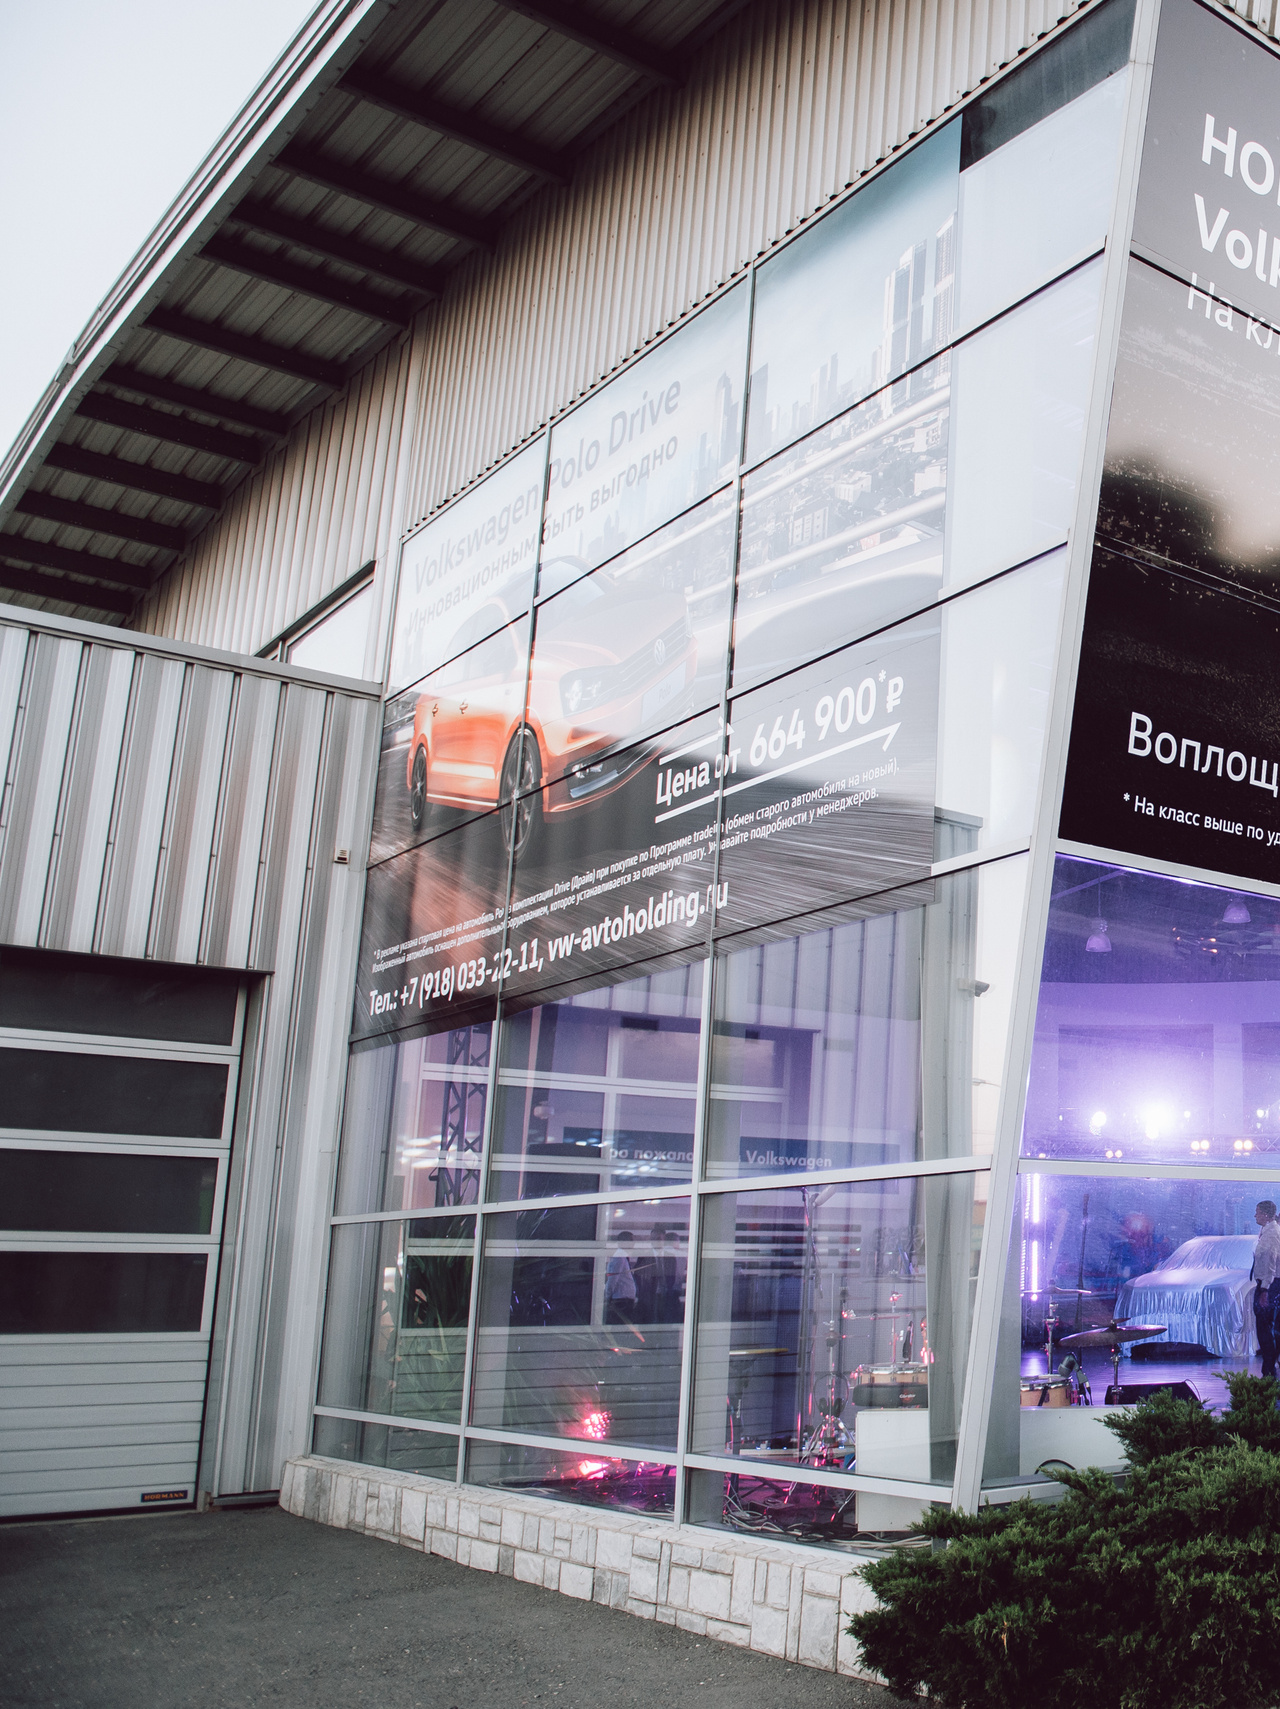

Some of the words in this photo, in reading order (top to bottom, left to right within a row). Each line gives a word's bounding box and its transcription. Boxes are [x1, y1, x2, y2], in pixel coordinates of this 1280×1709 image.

[1188, 272, 1234, 331] На
[406, 533, 537, 636] Инновационным
[542, 502, 584, 543] быть
[590, 435, 678, 512] выгодно
[415, 483, 539, 594] Volkswagen
[549, 437, 600, 490] Polo
[608, 380, 681, 458] Drive
[656, 762, 710, 806] Цена
[714, 748, 741, 778] от
[749, 708, 806, 766] 664
[550, 893, 576, 912] которое
[576, 872, 632, 905] устанавливается
[632, 870, 641, 882] за
[641, 855, 682, 878] отдельную
[682, 847, 706, 864] плату.
[750, 812, 807, 840] подробности
[808, 809, 815, 824] у
[816, 787, 879, 818] менеджеров.
[554, 881, 571, 896] Drive
[571, 868, 596, 892] (Драйв)
[596, 866, 609, 881] при
[610, 855, 638, 874] покупке
[639, 851, 649, 863] по
[650, 834, 692, 860] Программе
[725, 812, 755, 834] (обмен
[756, 799, 790, 819] старого
[791, 780, 846, 808] автомобиля
[848, 773, 860, 790] на
[862, 756, 900, 785] новый).
[1134, 795, 1155, 816] На
[1159, 806, 1200, 826] класс
[1204, 815, 1243, 835] выше
[1247, 825, 1264, 840] по
[369, 989, 399, 1016] Тел.:
[400, 976, 419, 1008] +7
[419, 965, 456, 1009] (918)
[745, 1149, 832, 1170] Volkswagen
